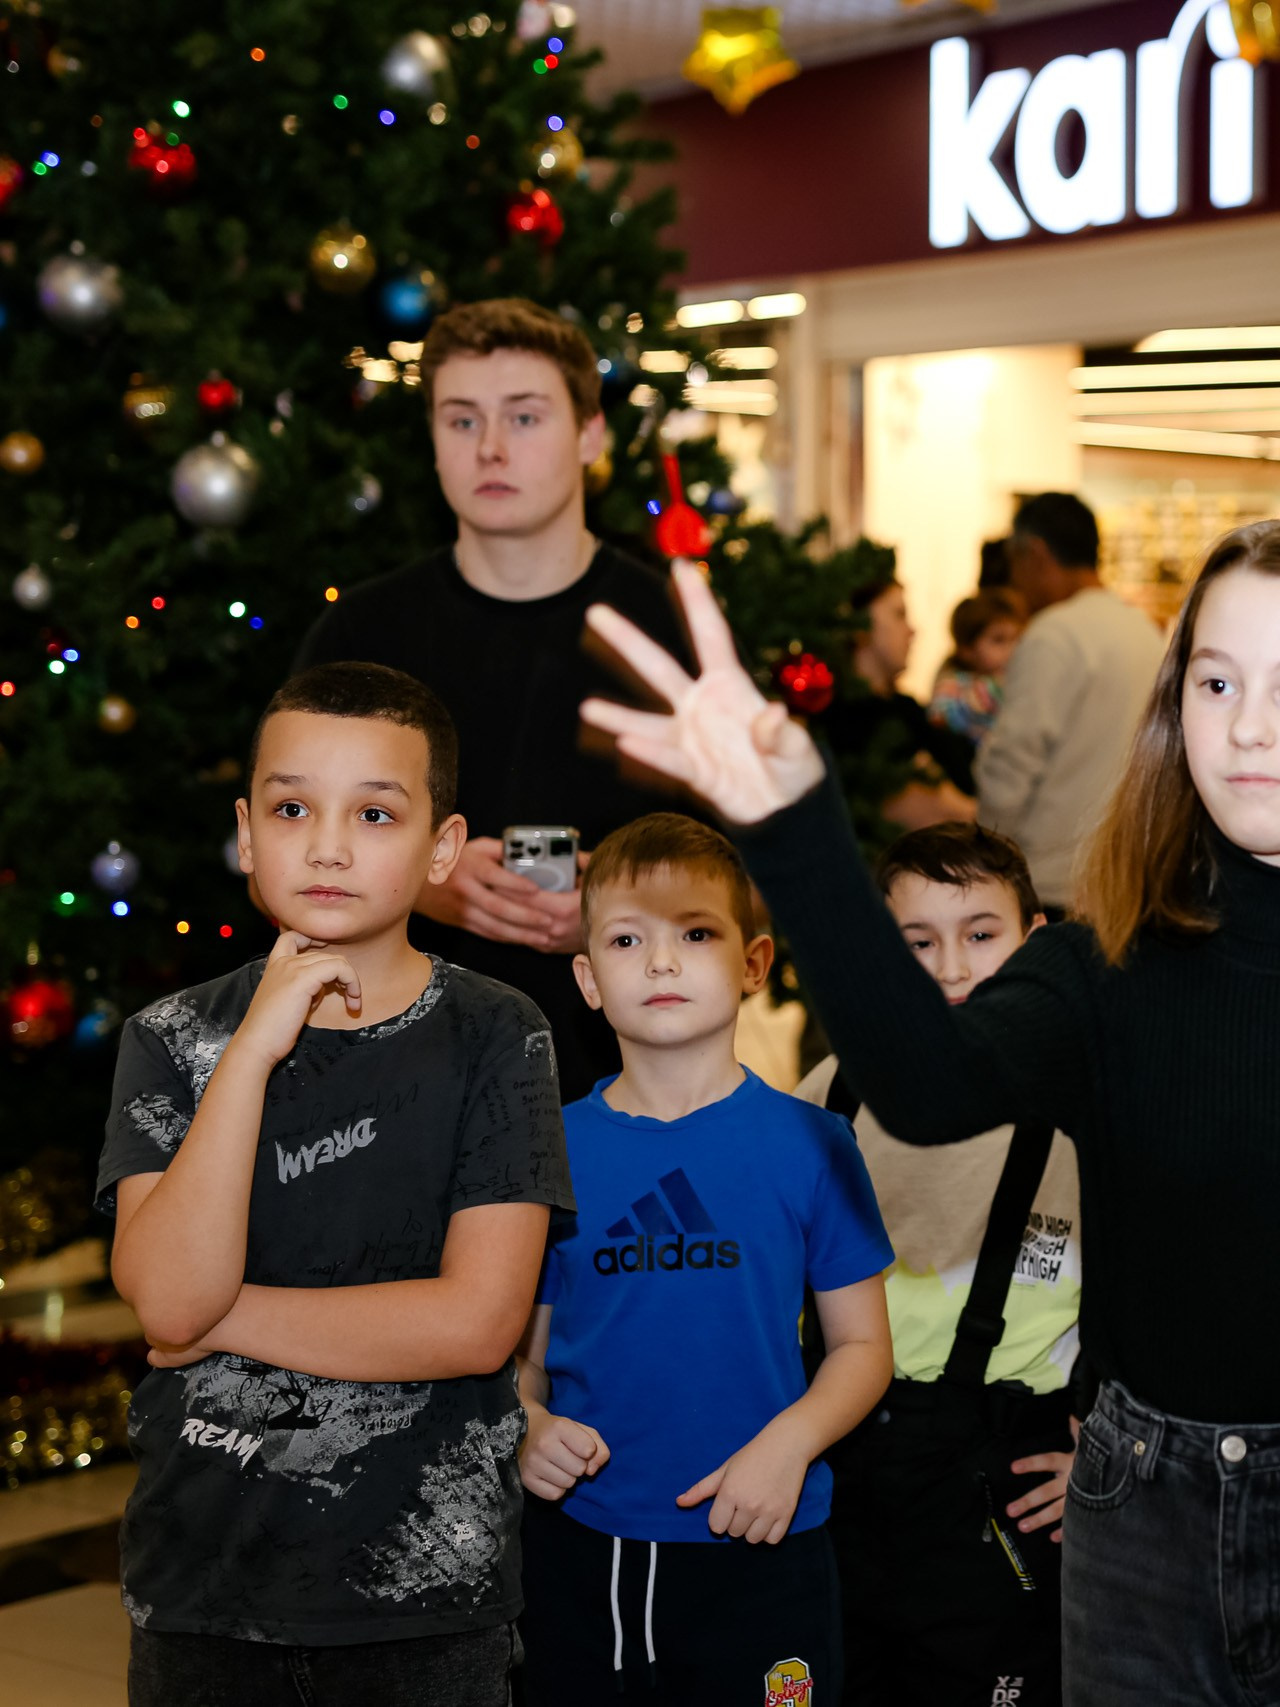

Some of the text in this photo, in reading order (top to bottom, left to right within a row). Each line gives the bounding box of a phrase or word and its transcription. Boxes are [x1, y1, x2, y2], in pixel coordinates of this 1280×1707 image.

[928, 0, 1255, 249] kari
[275, 1117, 377, 1184] DREAM
[593, 1233, 741, 1277] adidas
[179, 1418, 263, 1470] REAM
